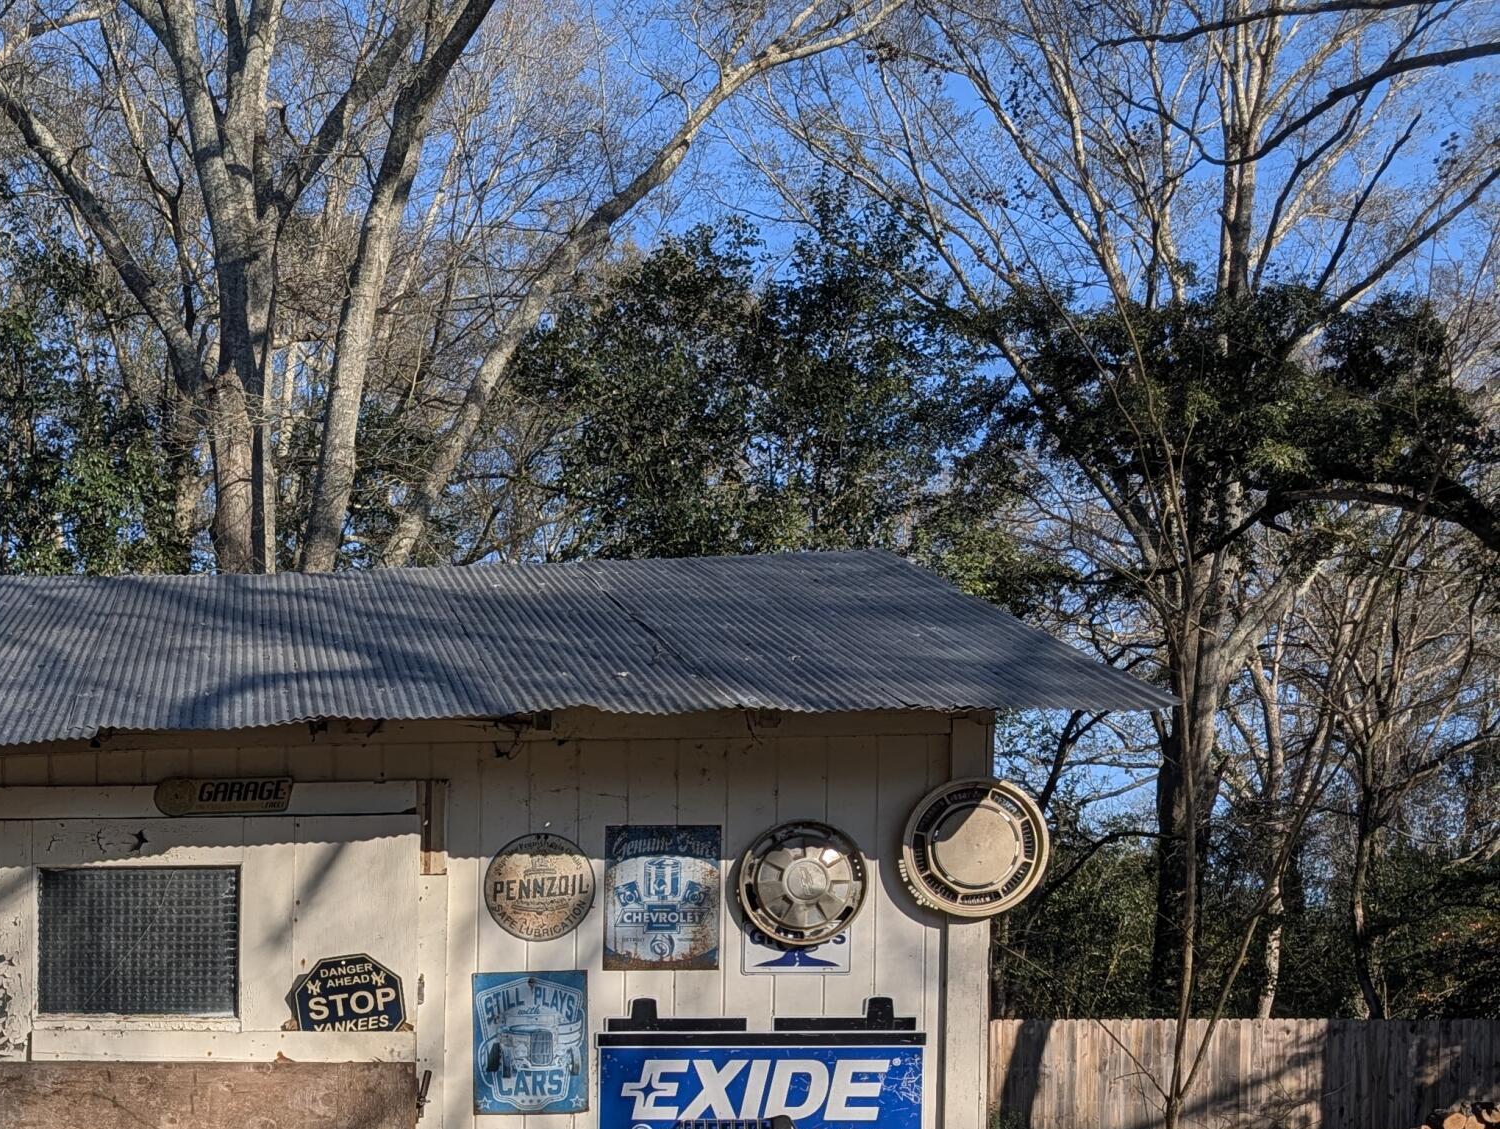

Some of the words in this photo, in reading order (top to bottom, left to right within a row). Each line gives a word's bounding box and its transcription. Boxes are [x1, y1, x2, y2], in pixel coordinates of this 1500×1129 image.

[199, 780, 289, 802] GARAGE
[493, 874, 589, 902] PENNZOIL
[494, 904, 517, 929] SAFE
[519, 900, 587, 937] LUBRICATION
[623, 912, 701, 923] CHEVROLET
[320, 963, 373, 978] DANGER
[326, 974, 370, 988] AHEAD
[308, 987, 396, 1020] STOP
[484, 988, 525, 1025] STILL
[534, 987, 575, 1022] PLAYS
[518, 1006, 540, 1015] with
[314, 1015, 389, 1032] YANKEES
[499, 1070, 565, 1096] CARS
